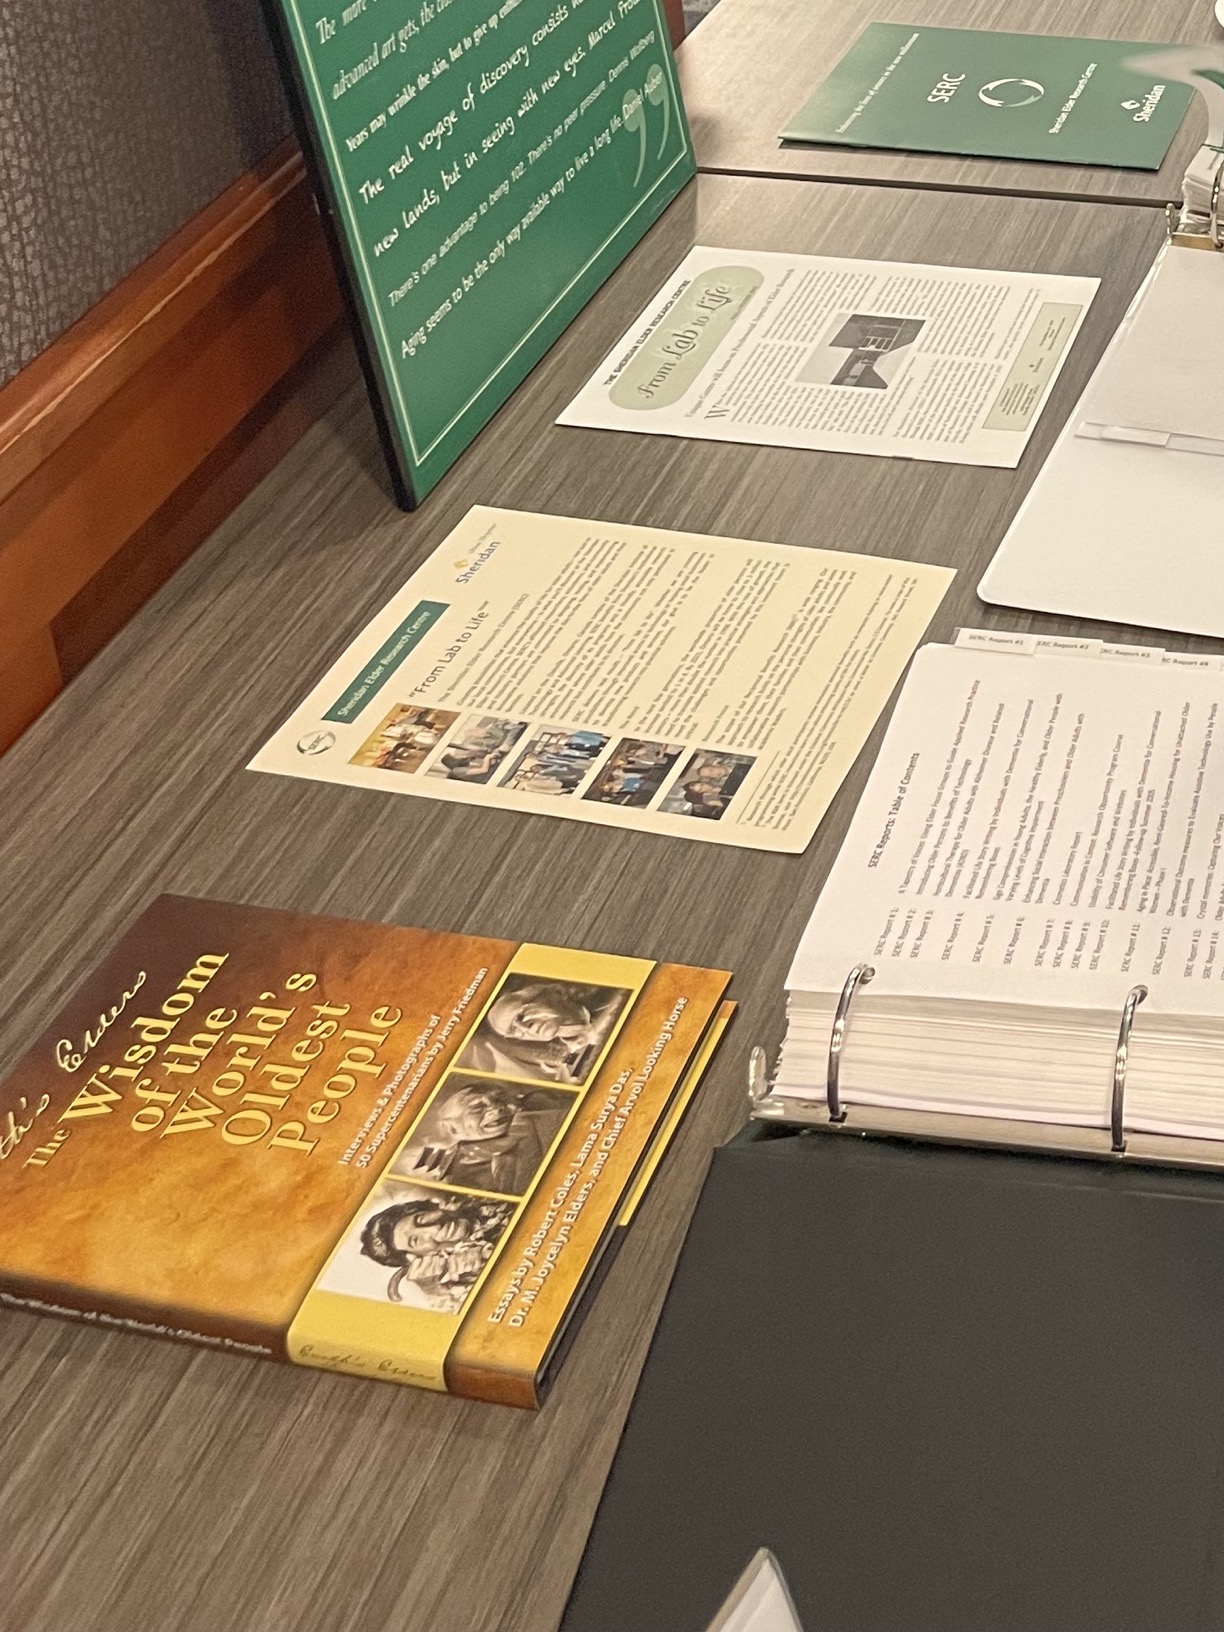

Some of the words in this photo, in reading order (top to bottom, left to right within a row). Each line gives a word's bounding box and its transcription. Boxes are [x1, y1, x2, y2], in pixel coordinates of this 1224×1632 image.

[358, 178, 385, 204] The
[387, 144, 414, 179] real
[417, 109, 458, 151] voyage
[461, 81, 475, 111] of
[479, 44, 530, 94] discovery
[531, 4, 569, 46] consists
[926, 72, 966, 103] SERC
[1132, 84, 1166, 122] Sheridan
[695, 285, 733, 311] Life
[691, 315, 710, 326] to
[661, 328, 699, 360] Lab
[637, 361, 677, 398] From
[454, 540, 501, 584] Sheridan
[336, 684, 370, 716] Sheridan
[363, 664, 385, 684] Elder
[379, 633, 412, 665] Research
[405, 610, 431, 634] Centre
[437, 644, 462, 663] Lab
[455, 631, 472, 643] to
[899, 752, 920, 785] Contents
[887, 794, 904, 815] Table
[897, 784, 907, 794] of
[875, 817, 896, 849] Reports:
[867, 848, 884, 868] SERC
[451, 967, 488, 1015] Friedman
[428, 1013, 441, 1027] of
[435, 1014, 461, 1042] Jerry
[661, 996, 688, 1032] Horse
[22, 1128, 69, 1168] The
[56, 952, 229, 1123] Wisdom
[159, 972, 317, 1138] World's
[380, 1027, 433, 1096] Photographs
[424, 1040, 448, 1057] by
[632, 1032, 672, 1081] Looking
[131, 1077, 181, 1131] of
[160, 1007, 238, 1076] the
[221, 1000, 350, 1144] Oldest
[266, 1005, 401, 1154] People
[608, 1067, 638, 1095] Das,
[361, 1055, 434, 1153] Supercentenarians
[376, 1096, 389, 1107] &
[589, 1095, 622, 1132] Surya
[614, 1078, 644, 1116] Arvol
[337, 1106, 382, 1164] Interviews
[569, 1132, 604, 1169] Lama
[595, 1114, 626, 1151] Chief
[355, 1150, 372, 1168] 50
[588, 1148, 609, 1176] and
[549, 1169, 582, 1212] Coles,
[560, 1178, 596, 1225] Elders,
[521, 1208, 564, 1260] Robert
[530, 1220, 571, 1285] Joycelyn
[510, 1256, 539, 1278] by
[487, 1275, 521, 1322] Essays
[519, 1282, 540, 1306] M.
[505, 1304, 529, 1326] Dr.
